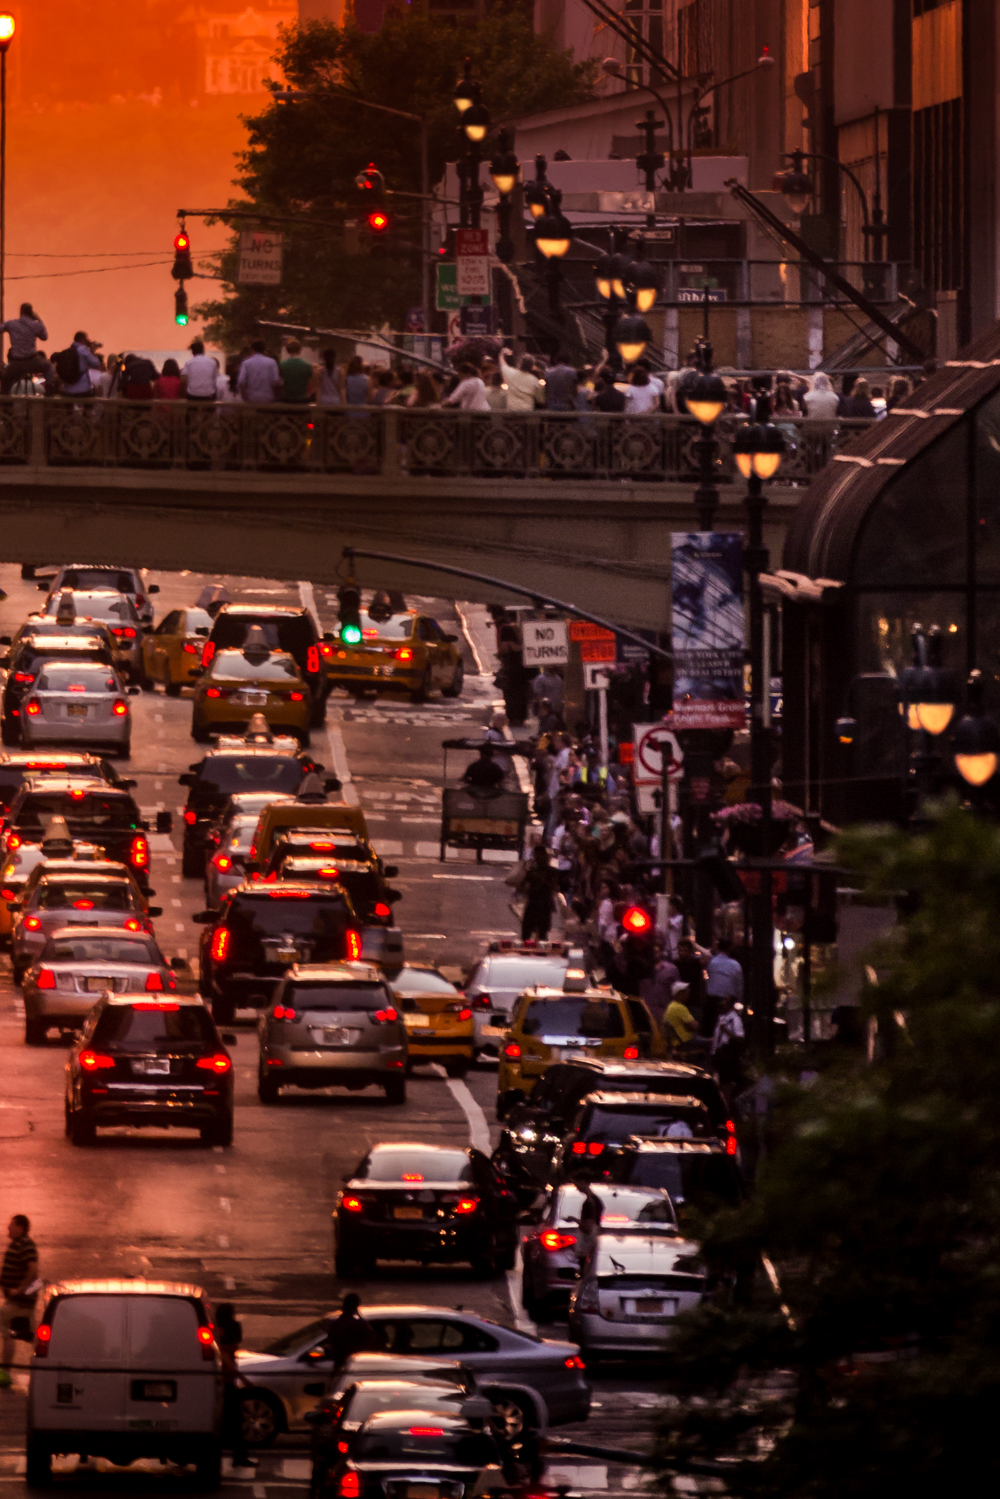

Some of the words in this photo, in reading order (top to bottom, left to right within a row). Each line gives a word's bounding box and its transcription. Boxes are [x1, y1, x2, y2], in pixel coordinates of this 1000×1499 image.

[251, 239, 273, 254] NO
[460, 243, 484, 254] ZONE
[241, 258, 282, 270] TURNS
[535, 628, 555, 641] NO
[526, 646, 567, 659] TURNS
